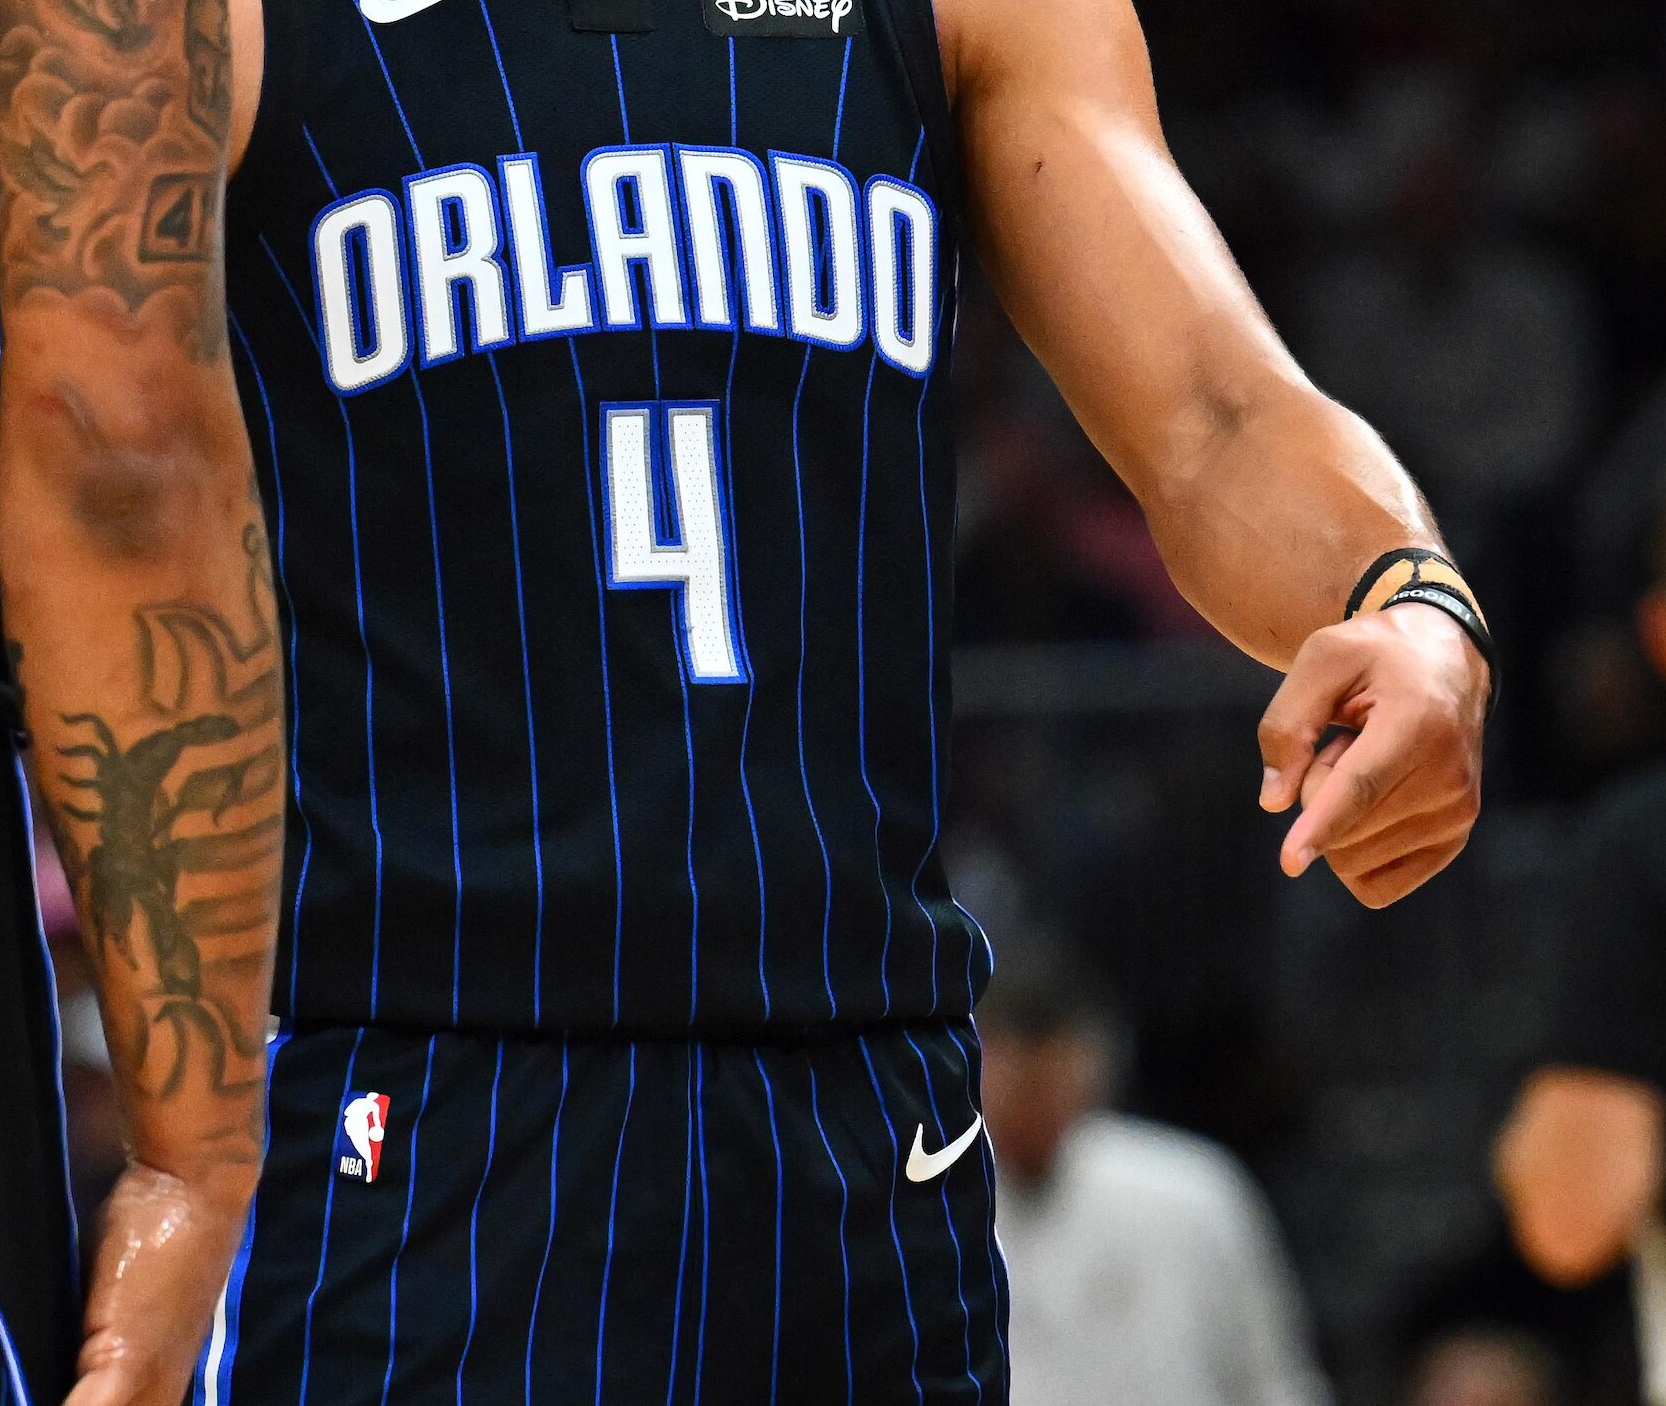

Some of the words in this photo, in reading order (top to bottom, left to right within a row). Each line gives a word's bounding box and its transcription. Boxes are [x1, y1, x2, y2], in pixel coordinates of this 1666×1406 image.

[309, 143, 939, 396] ORLANDO
[599, 399, 750, 686] 4
[339, 1155, 364, 1177] NBA
